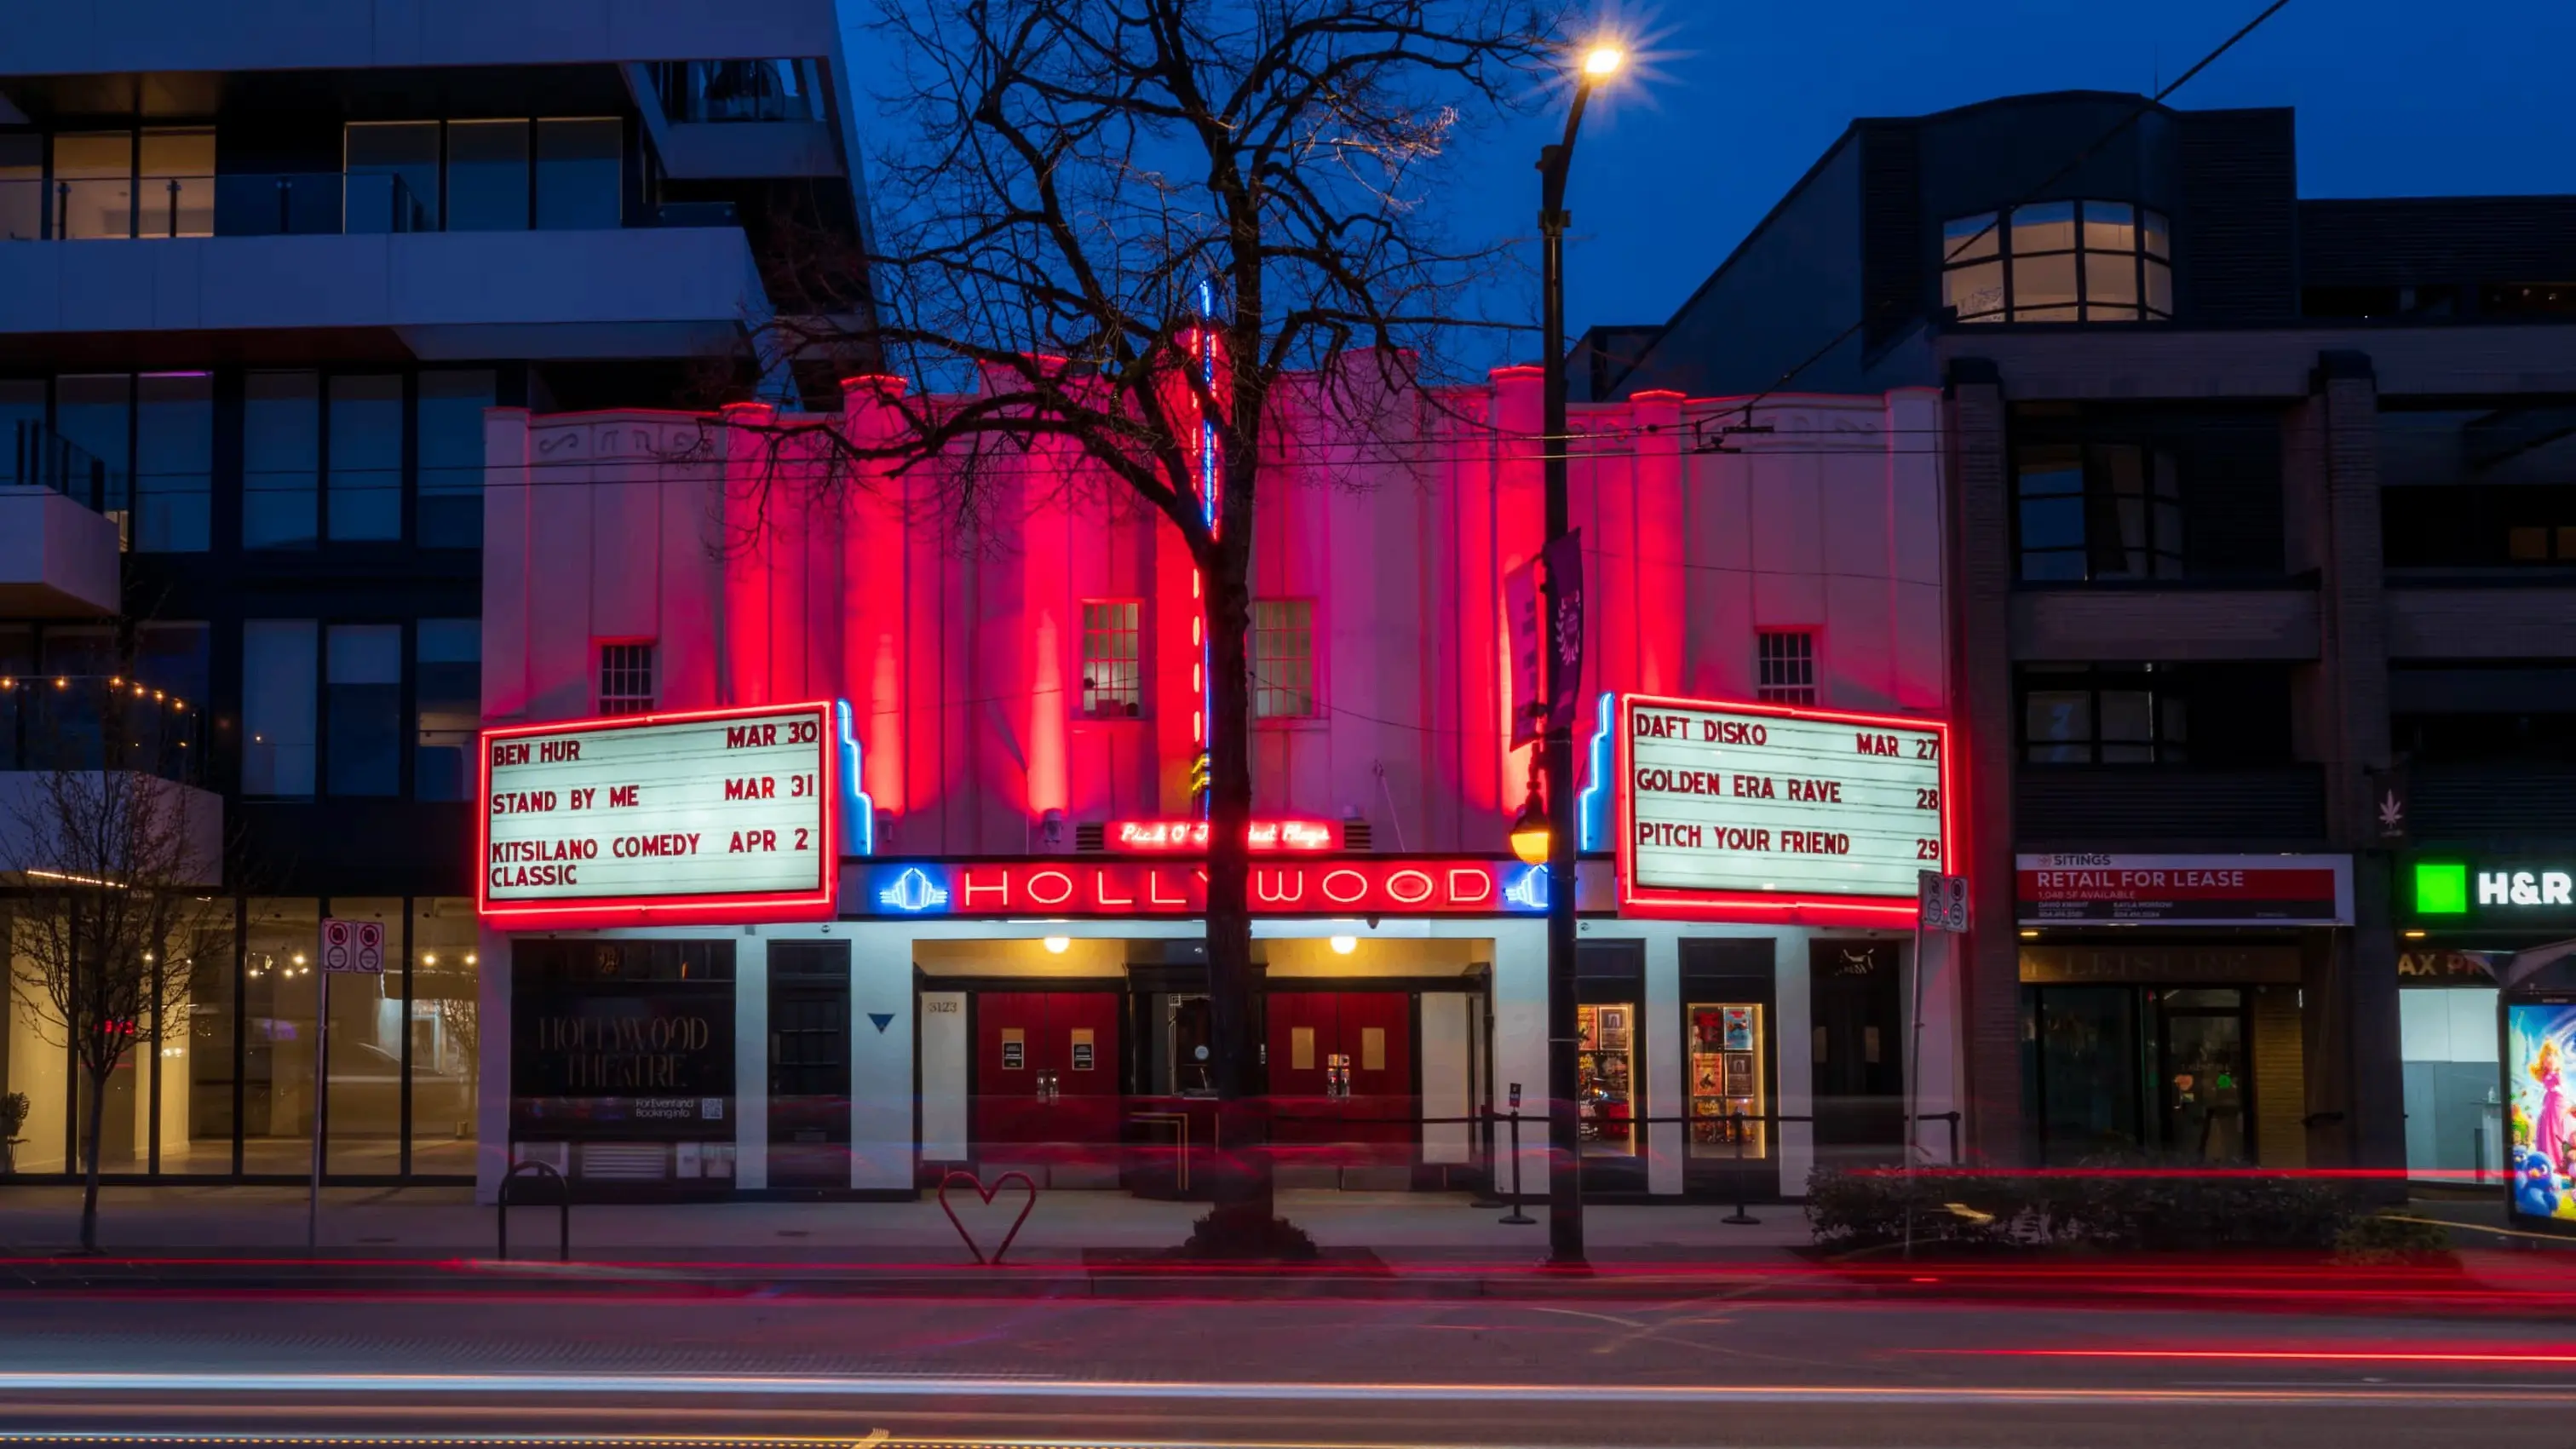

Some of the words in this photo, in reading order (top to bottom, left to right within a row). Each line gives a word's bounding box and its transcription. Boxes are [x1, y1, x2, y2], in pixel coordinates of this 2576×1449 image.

[727, 724, 776, 750] MAR
[788, 721, 819, 744] 30
[1636, 714, 1690, 739] DAFT
[1704, 720, 1767, 746] DISKO
[1855, 732, 1899, 757] MAR
[1916, 739, 1939, 760] 27
[493, 743, 530, 767] BEN
[540, 740, 580, 762] HUR
[492, 791, 557, 814] STAND
[570, 788, 596, 810] BY
[609, 785, 640, 808] ME
[724, 776, 775, 801] MAR
[791, 773, 814, 797] 31
[1636, 768, 1720, 796] GOLDEN
[1734, 774, 1774, 799] ERA
[1788, 779, 1842, 803] RAVE
[1916, 788, 1939, 810] 28
[492, 838, 597, 863] KITSILANO
[612, 832, 701, 859] COMEDY
[728, 829, 776, 854] APR
[794, 828, 809, 851] 2
[1638, 822, 1702, 848] PITCH
[1714, 826, 1770, 852] YOUR
[1780, 830, 1849, 855] FRIEND
[1916, 838, 1940, 860] 29
[491, 865, 578, 888] CLASSIC
[2055, 854, 2111, 866] SITINGS
[964, 869, 1491, 907] HOLLWOOD
[2038, 872, 2115, 888] RETAIL
[2121, 871, 2165, 887] FOR
[2174, 871, 2245, 887] LEASE
[2081, 890, 2136, 900] AVAILABLE
[2478, 871, 2573, 906] H&R
[538, 1016, 709, 1051] HOLLYWOOD
